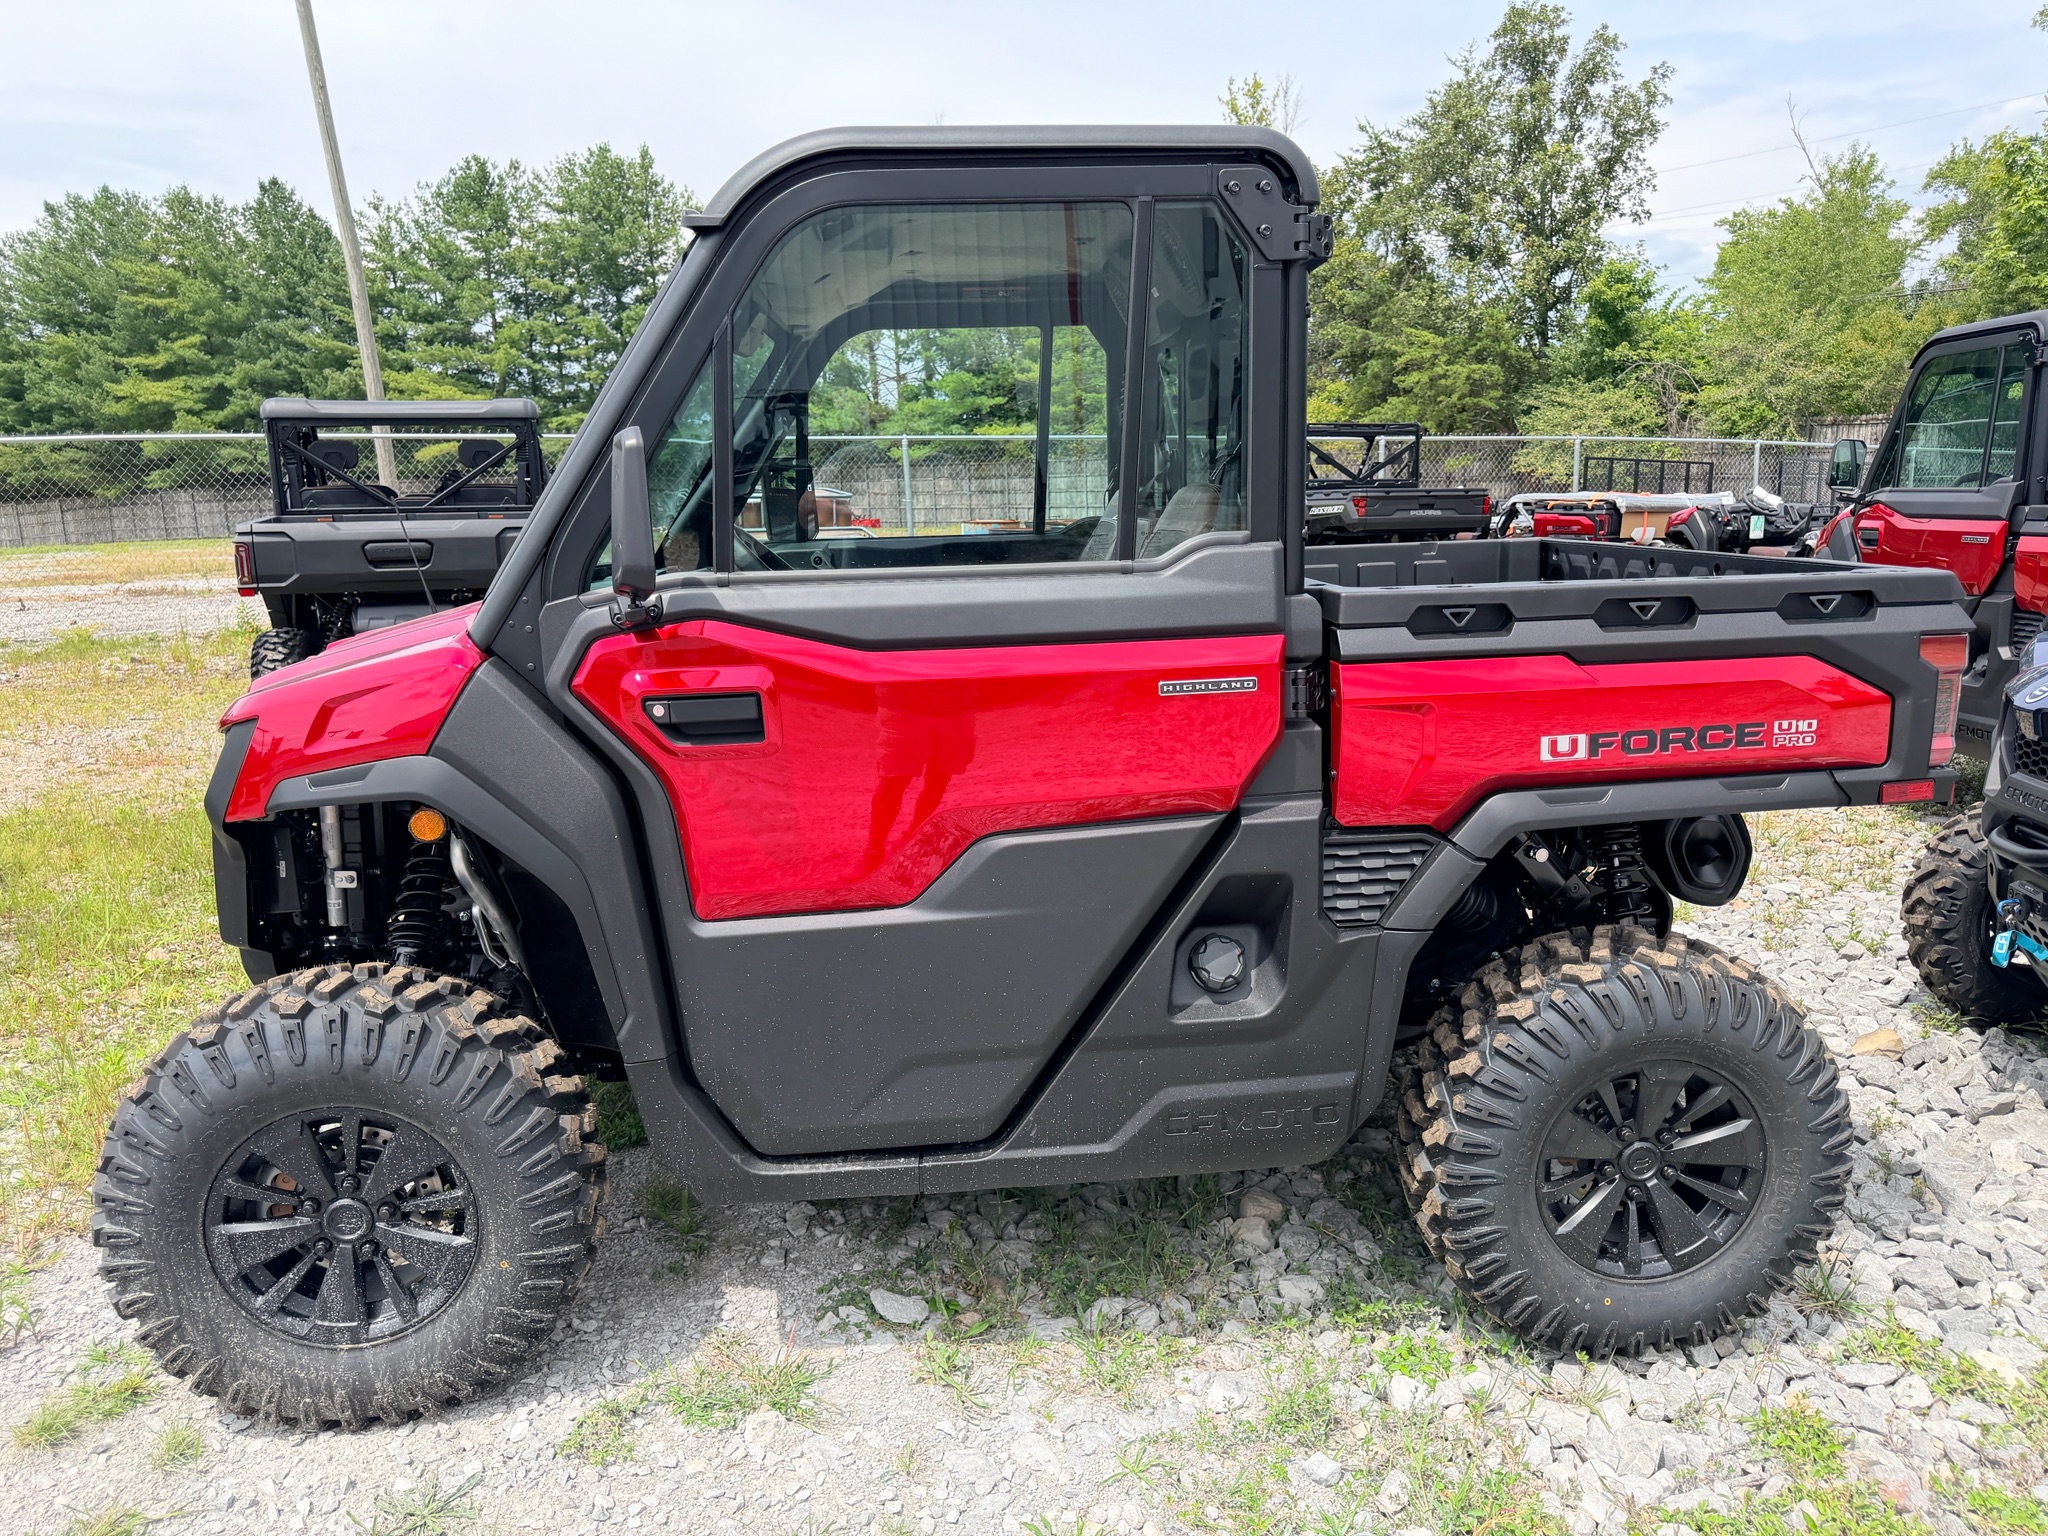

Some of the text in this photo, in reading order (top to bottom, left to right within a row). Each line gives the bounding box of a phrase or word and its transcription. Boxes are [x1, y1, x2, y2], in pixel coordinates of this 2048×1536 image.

[1163, 680, 1254, 692] HIGHLAND
[1773, 719, 1818, 734] U10
[1955, 724, 1992, 741] FMOT
[1773, 733, 1817, 748] PRO
[1163, 1102, 1341, 1137] CFMOTO
